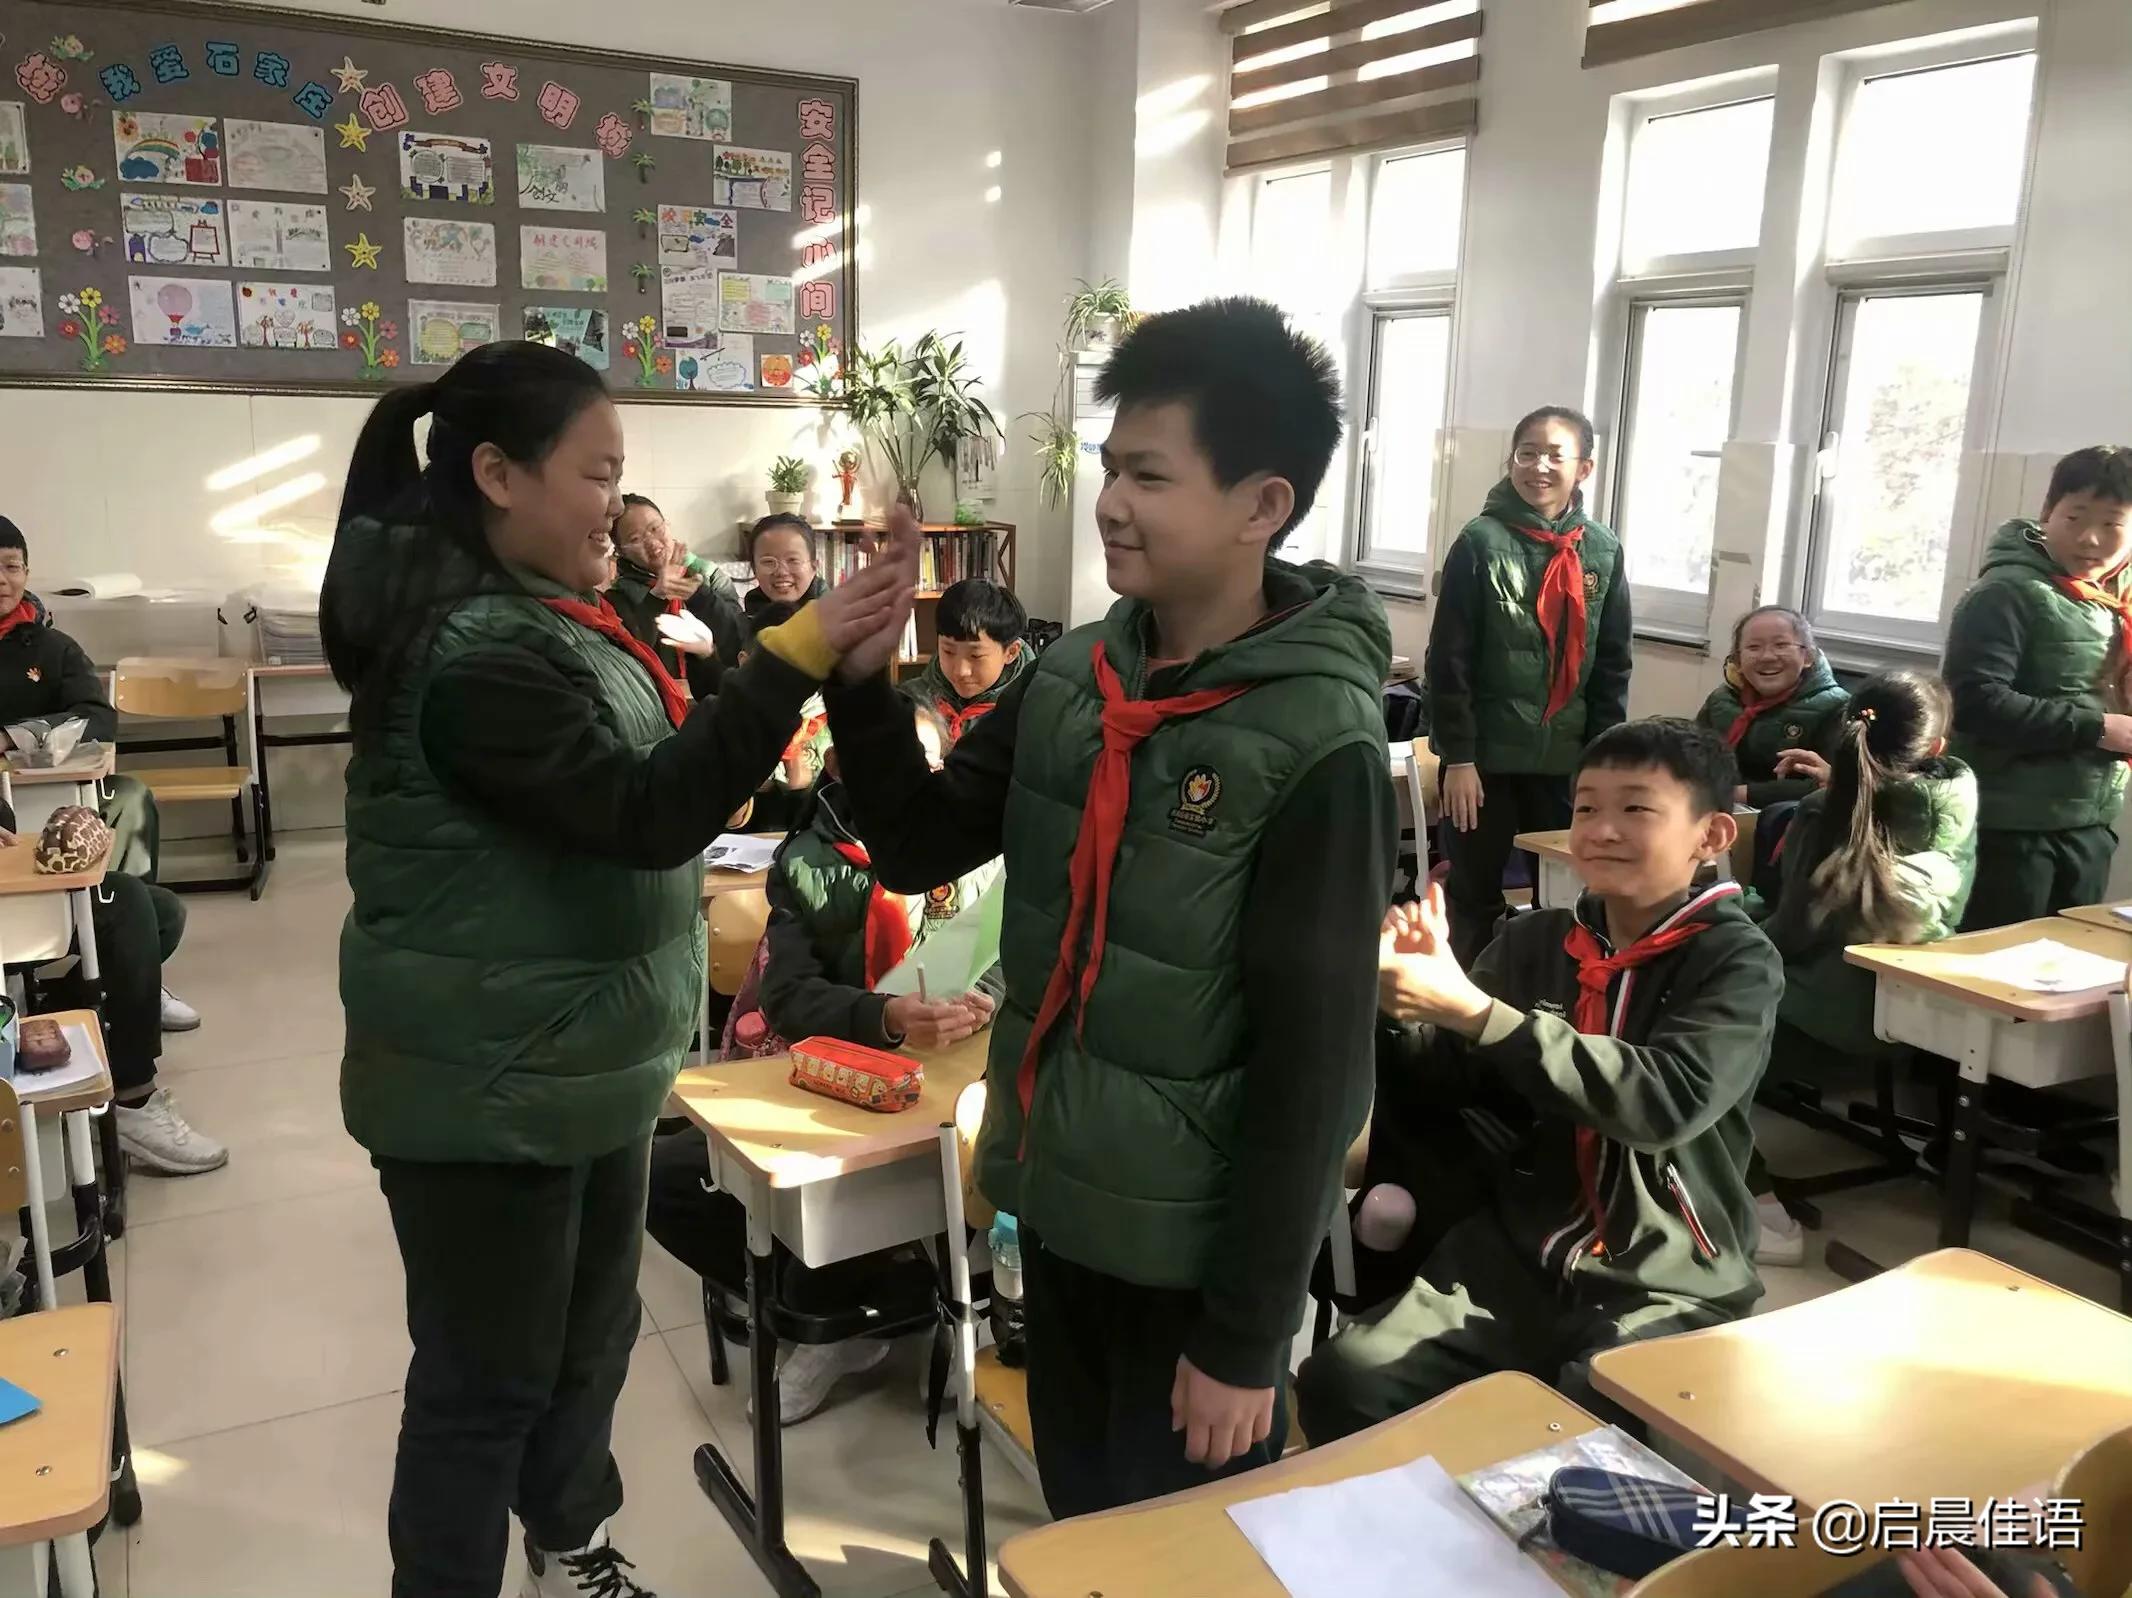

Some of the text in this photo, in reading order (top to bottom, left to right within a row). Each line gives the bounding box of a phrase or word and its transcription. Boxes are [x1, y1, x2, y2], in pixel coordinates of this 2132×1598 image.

[100, 41, 333, 119] 我爱石家庄
[799, 98, 837, 319] 安全记心间
